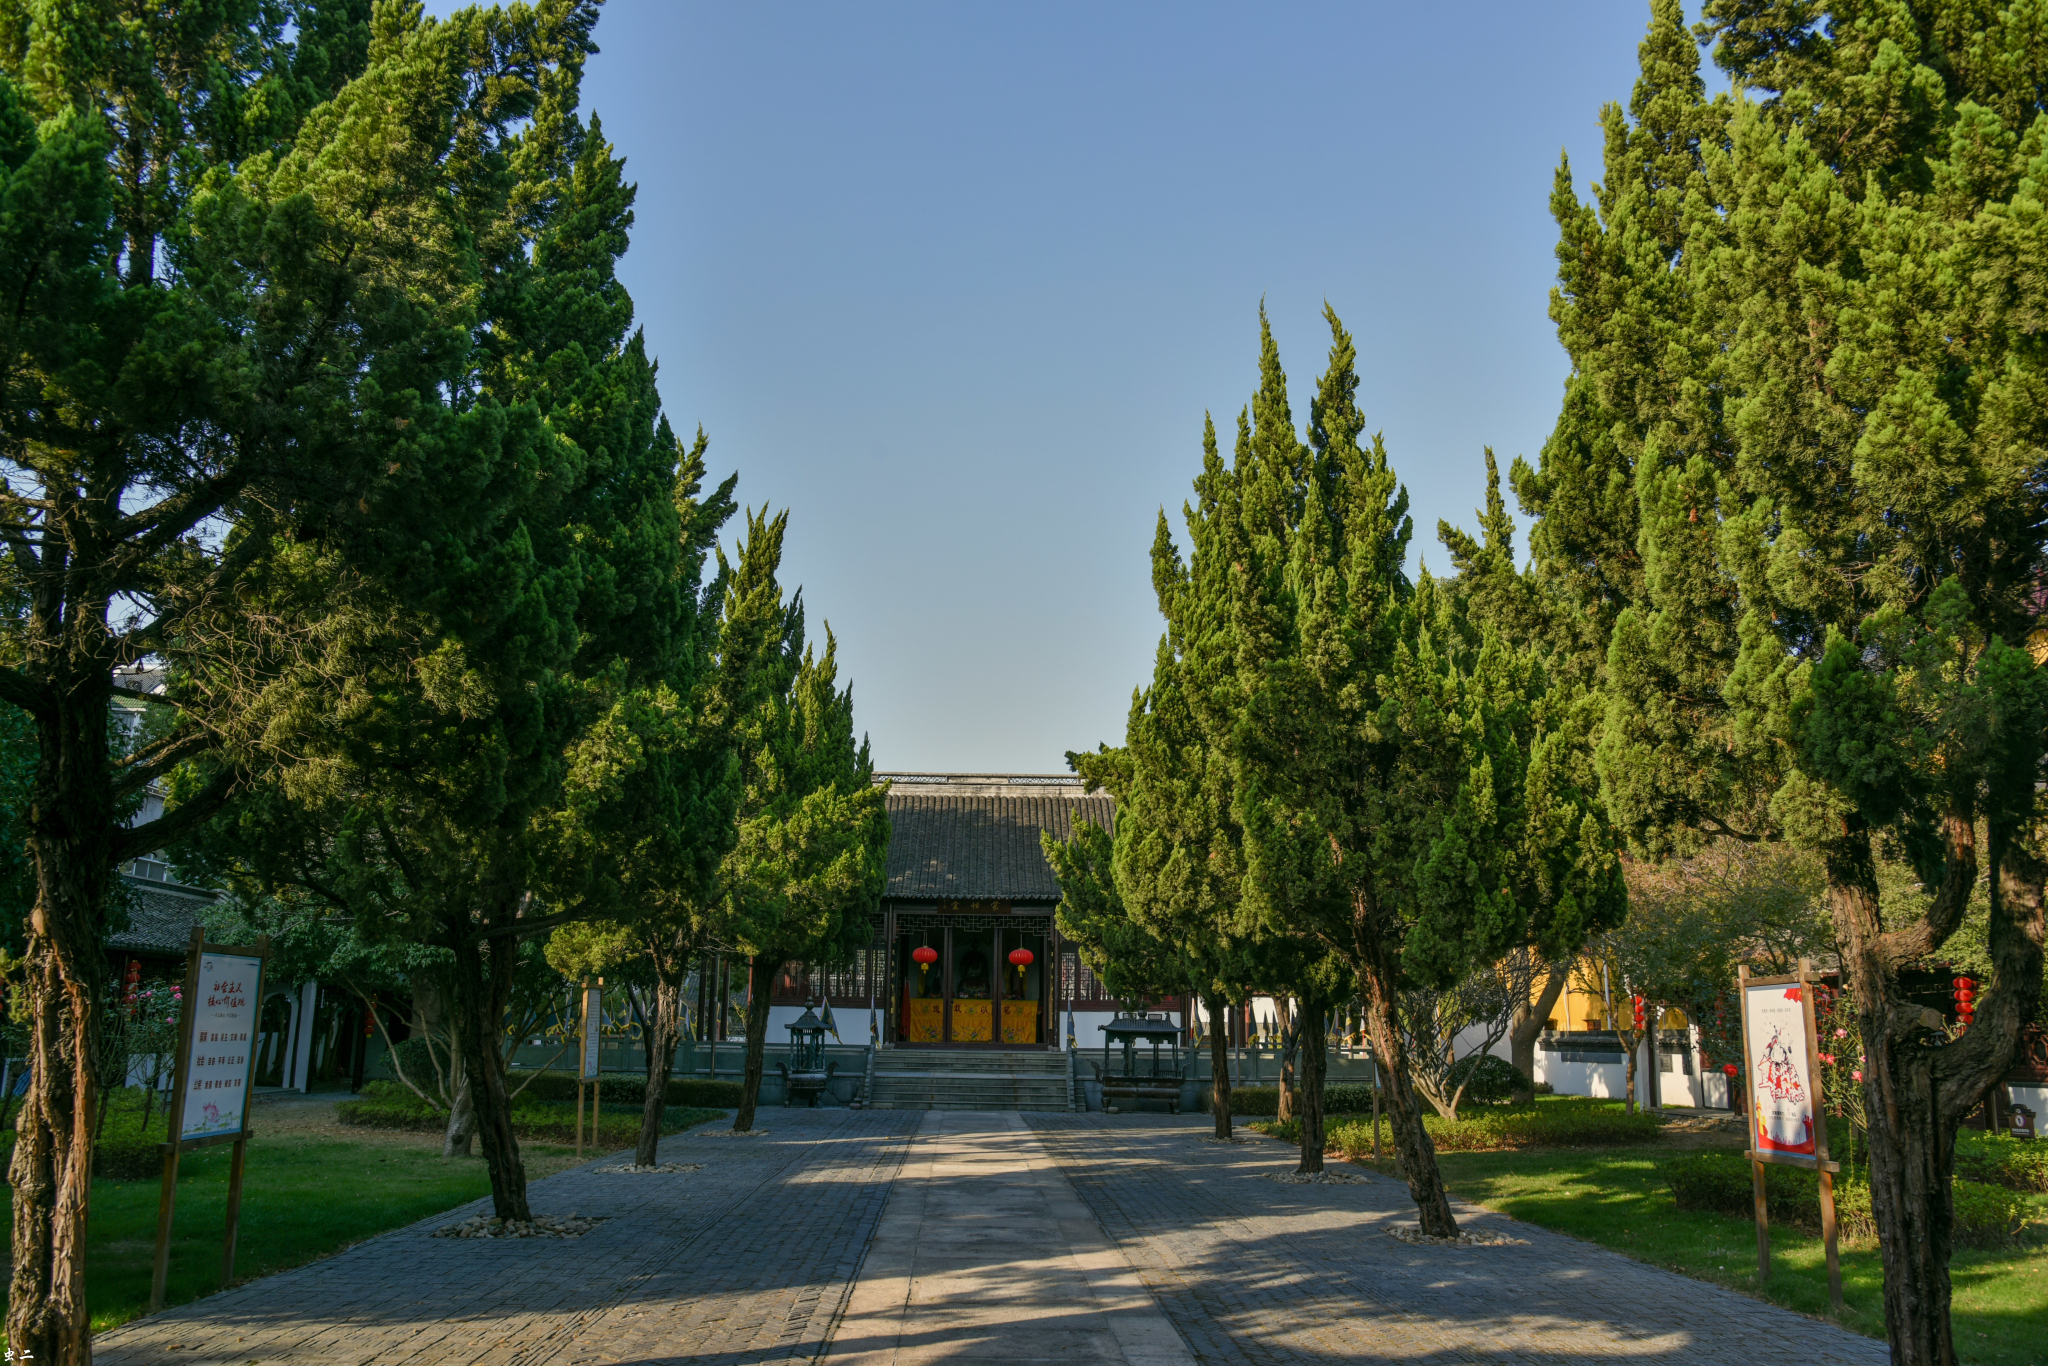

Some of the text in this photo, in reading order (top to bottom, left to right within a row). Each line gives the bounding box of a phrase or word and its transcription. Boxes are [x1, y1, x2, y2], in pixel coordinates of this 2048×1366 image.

[214, 980, 243, 993] 社会主义
[207, 995, 245, 1009] 核心价值观
